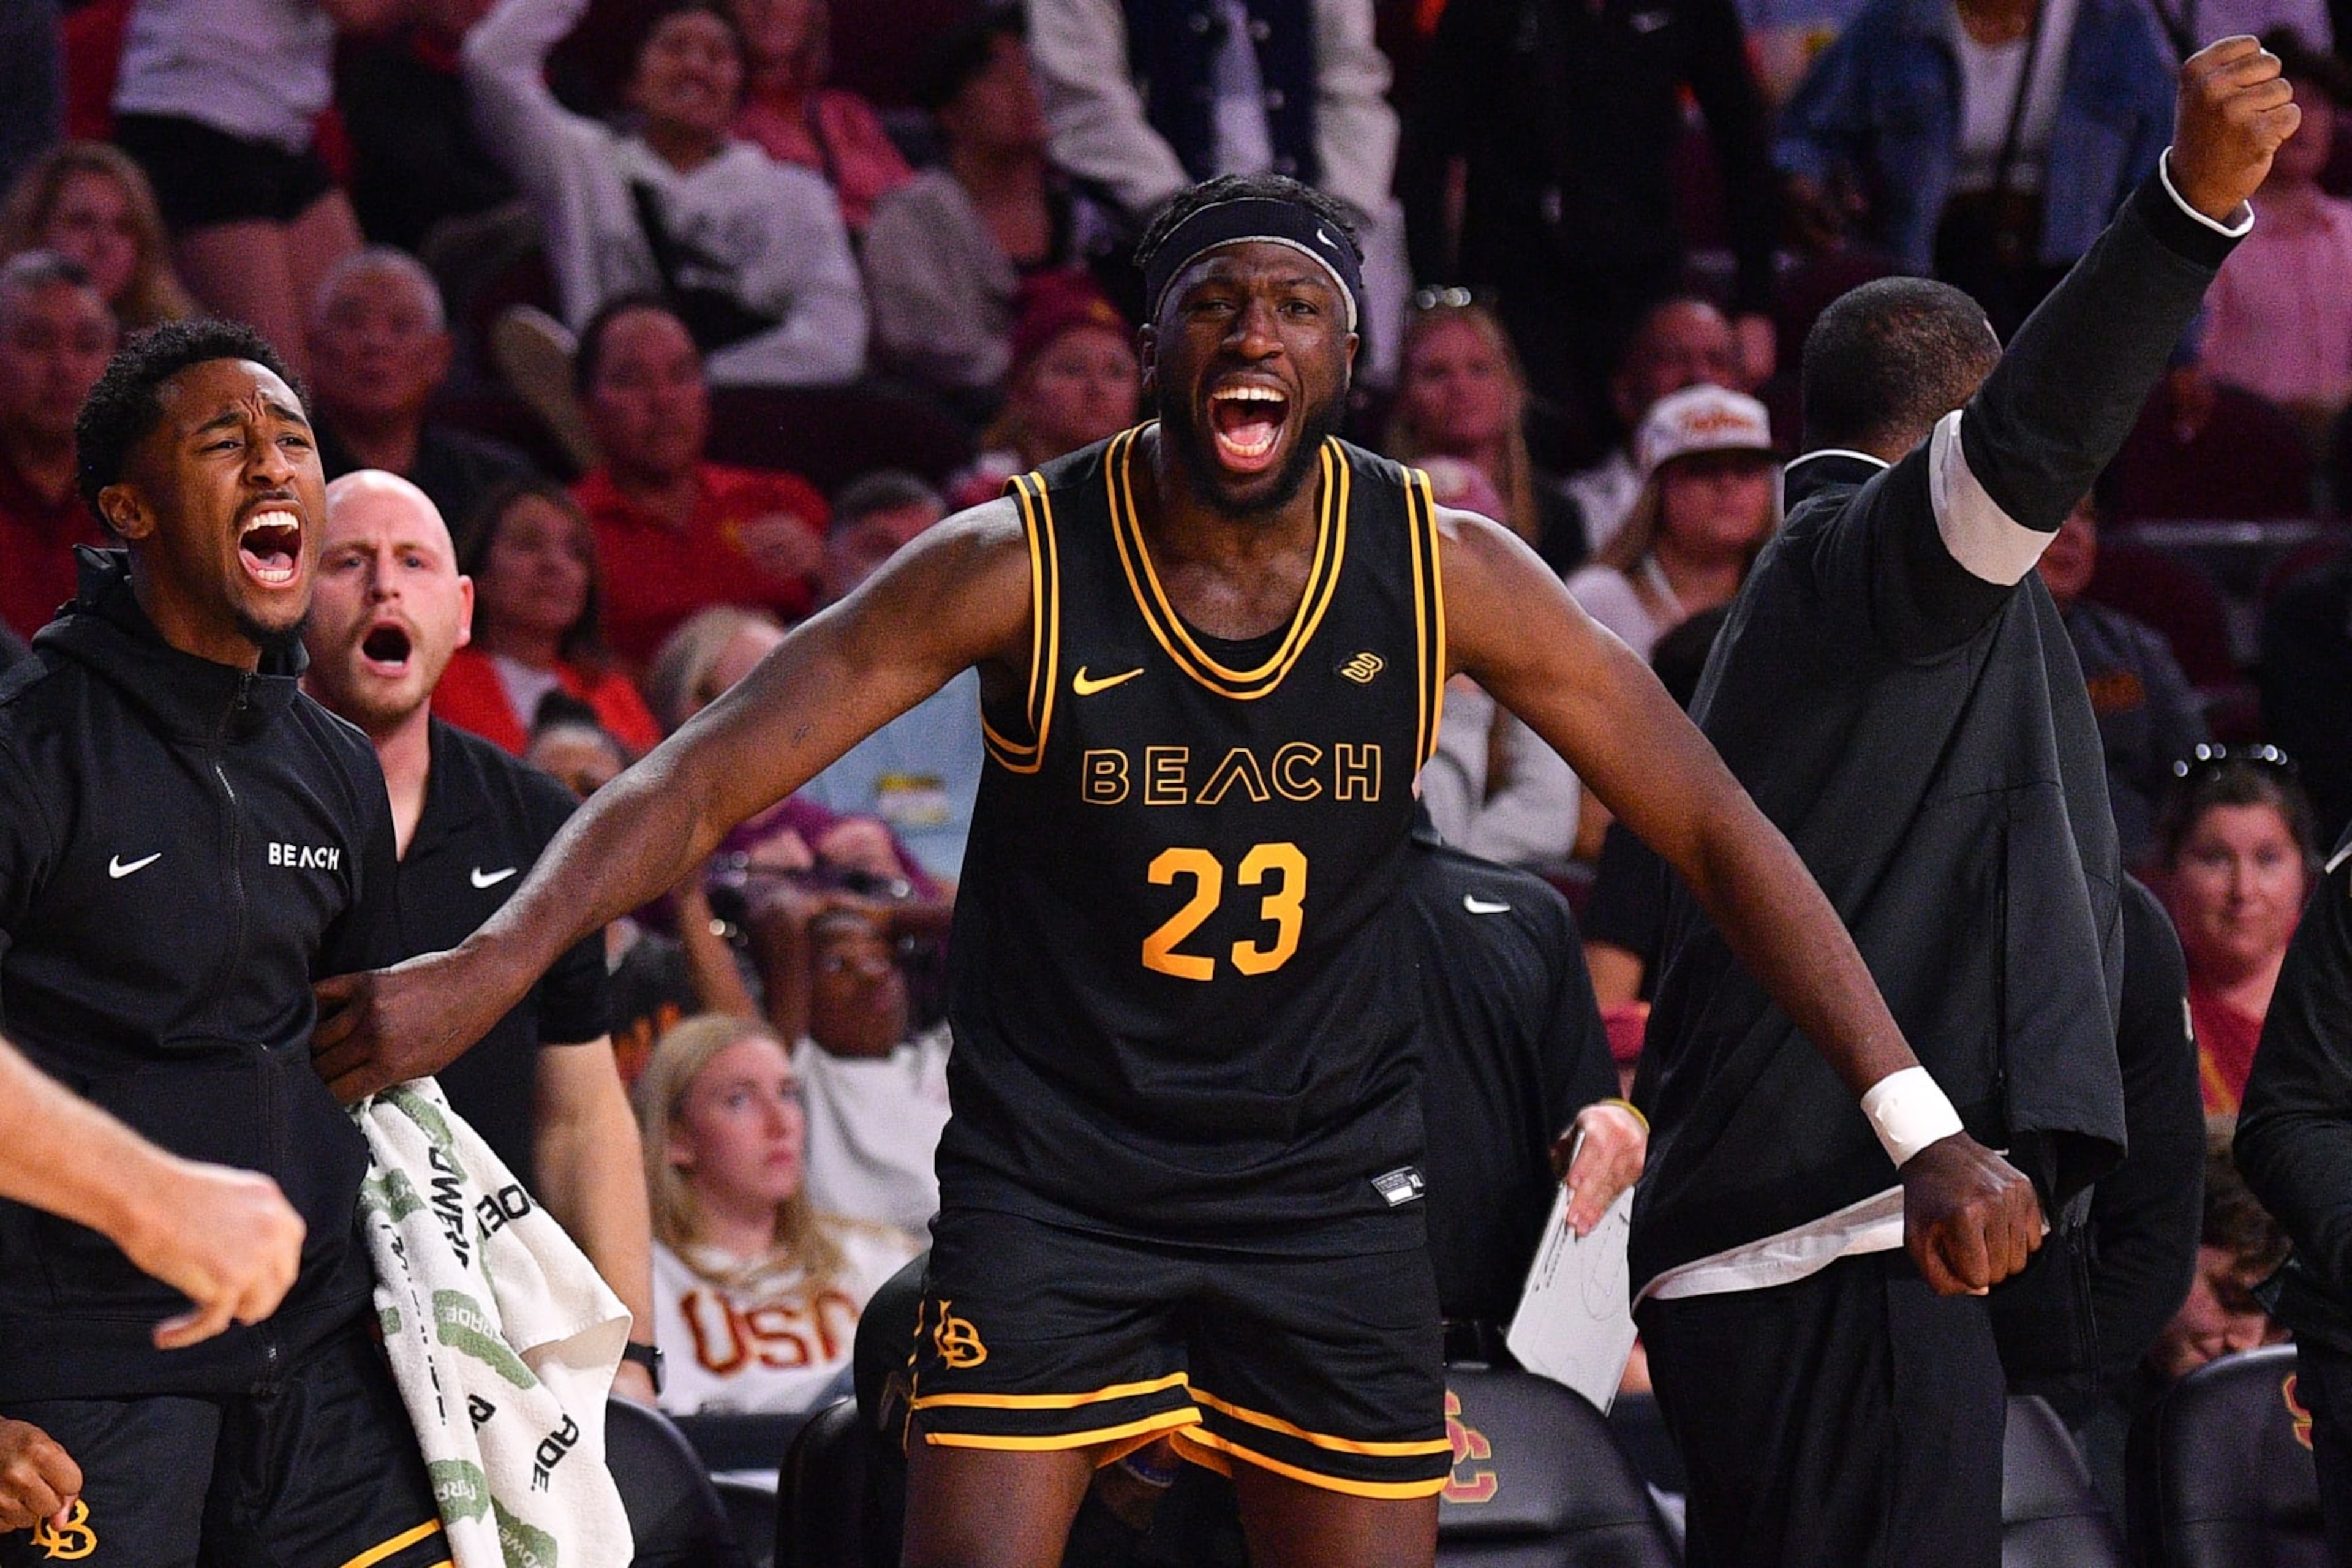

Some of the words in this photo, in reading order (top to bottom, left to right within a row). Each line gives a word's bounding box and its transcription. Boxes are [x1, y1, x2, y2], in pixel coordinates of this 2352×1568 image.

[1082, 741, 1382, 805] BEACH
[268, 842, 340, 870] BEACH
[1142, 842, 1308, 981] 23
